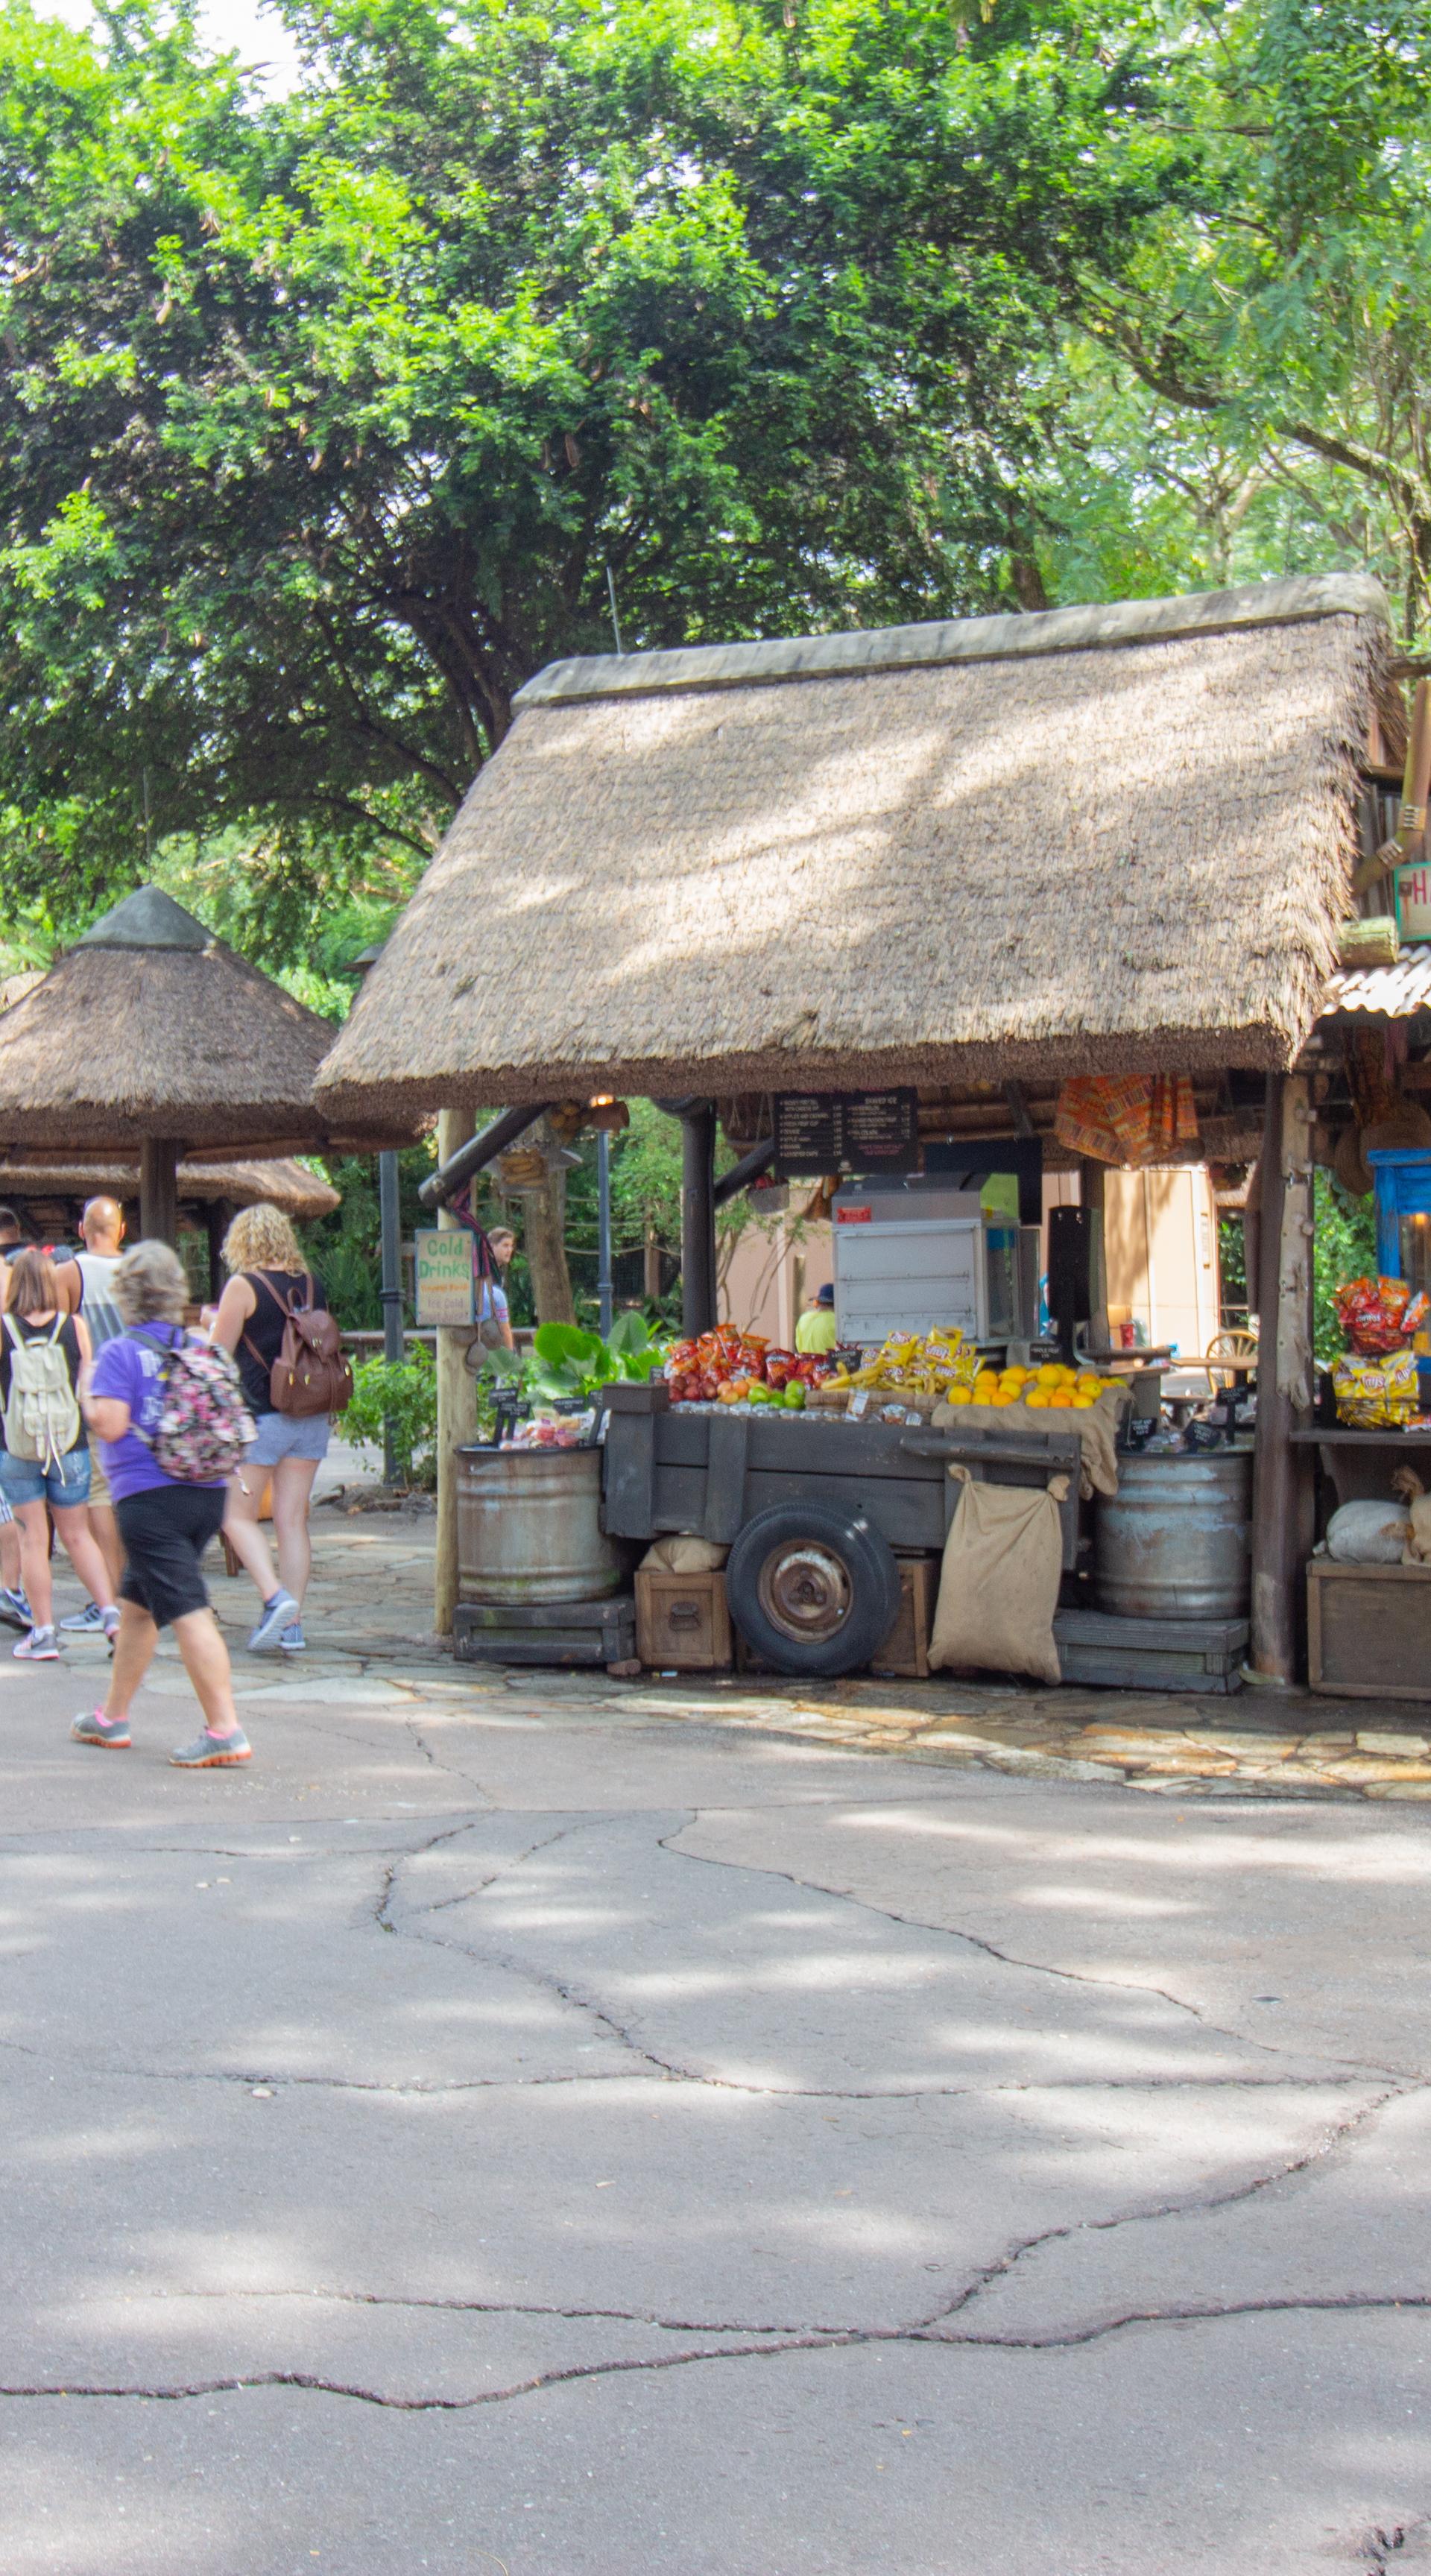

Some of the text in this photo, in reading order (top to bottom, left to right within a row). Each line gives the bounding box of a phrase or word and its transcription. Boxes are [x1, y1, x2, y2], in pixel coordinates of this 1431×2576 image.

[1412, 869, 1431, 906] H
[427, 1236, 463, 1257] Cold
[419, 1260, 470, 1279] Drinks
